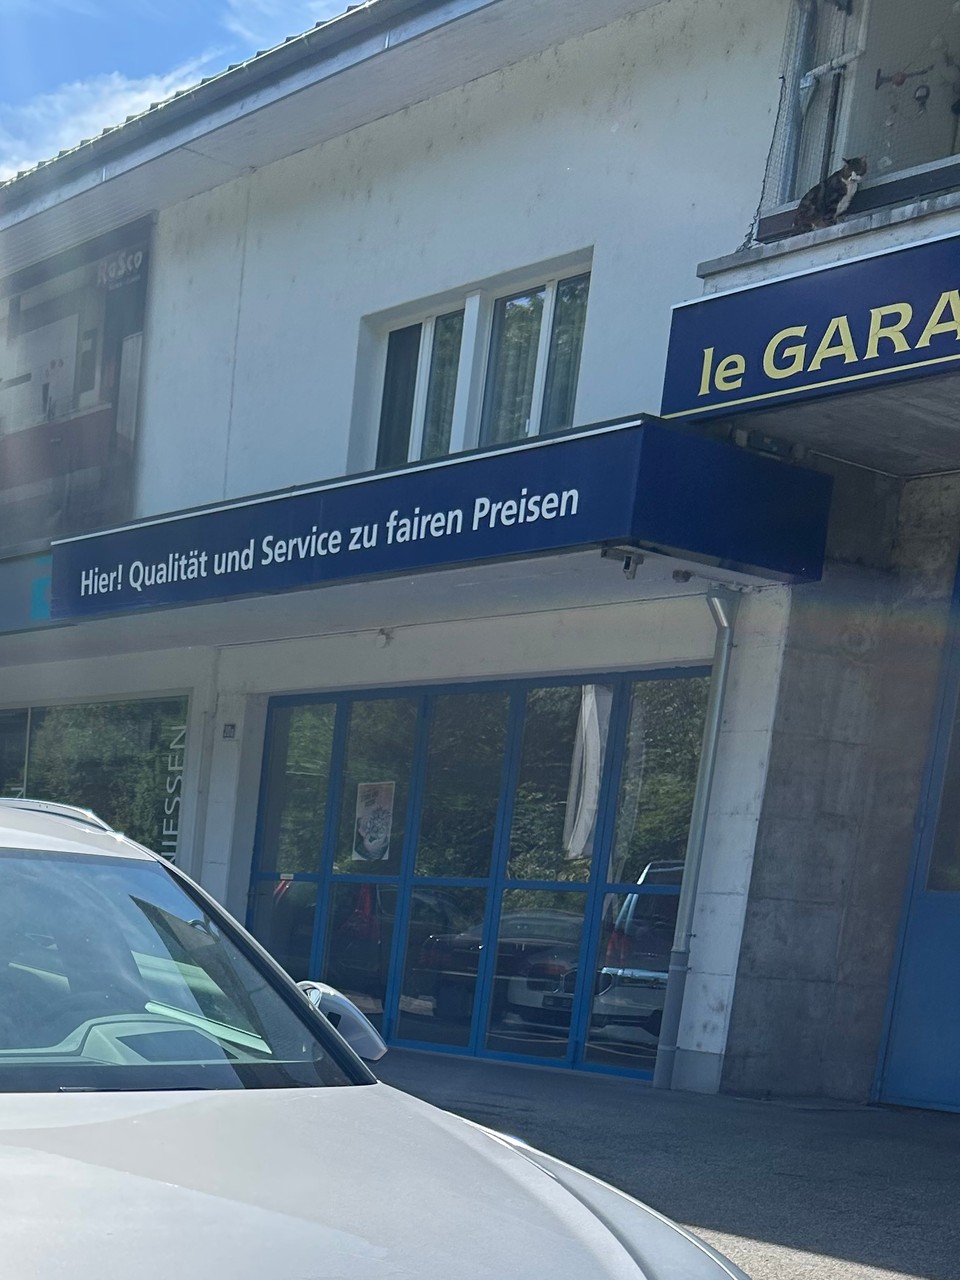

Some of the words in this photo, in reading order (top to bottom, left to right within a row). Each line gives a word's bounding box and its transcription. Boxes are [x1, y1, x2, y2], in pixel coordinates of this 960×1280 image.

[698, 347, 746, 396] le
[80, 563, 123, 597] Hier!
[128, 548, 208, 592] Qualität
[213, 538, 254, 574] und
[261, 525, 342, 566] Service
[348, 521, 378, 551] zu
[385, 507, 463, 545] fairen
[472, 488, 579, 532] Preisen
